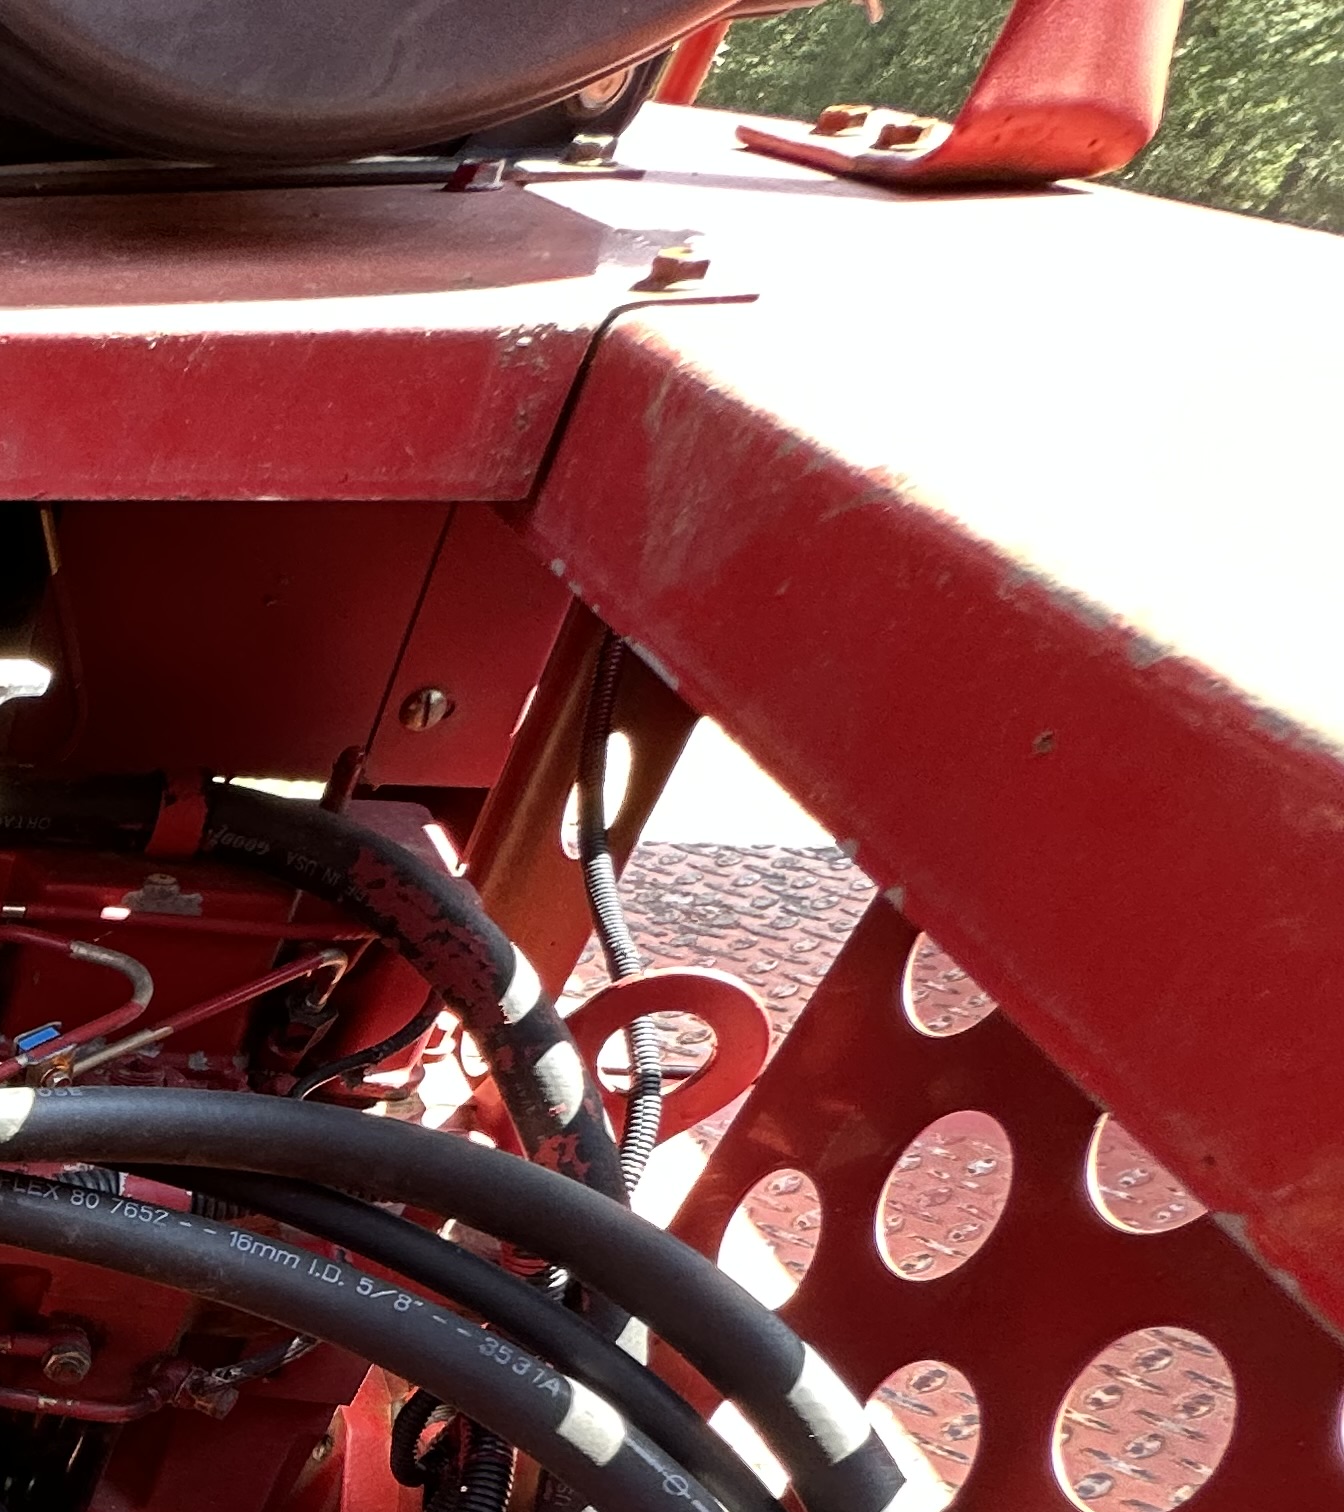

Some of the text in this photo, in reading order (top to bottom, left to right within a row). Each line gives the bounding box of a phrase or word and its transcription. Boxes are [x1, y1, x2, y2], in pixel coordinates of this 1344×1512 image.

[69, 1189, 100, 1210] 80
[110, 1198, 169, 1227] 7652
[229, 1230, 300, 1270] 16mm
[478, 1337, 561, 1398] 3531A
[553, 1482, 577, 1508] US
